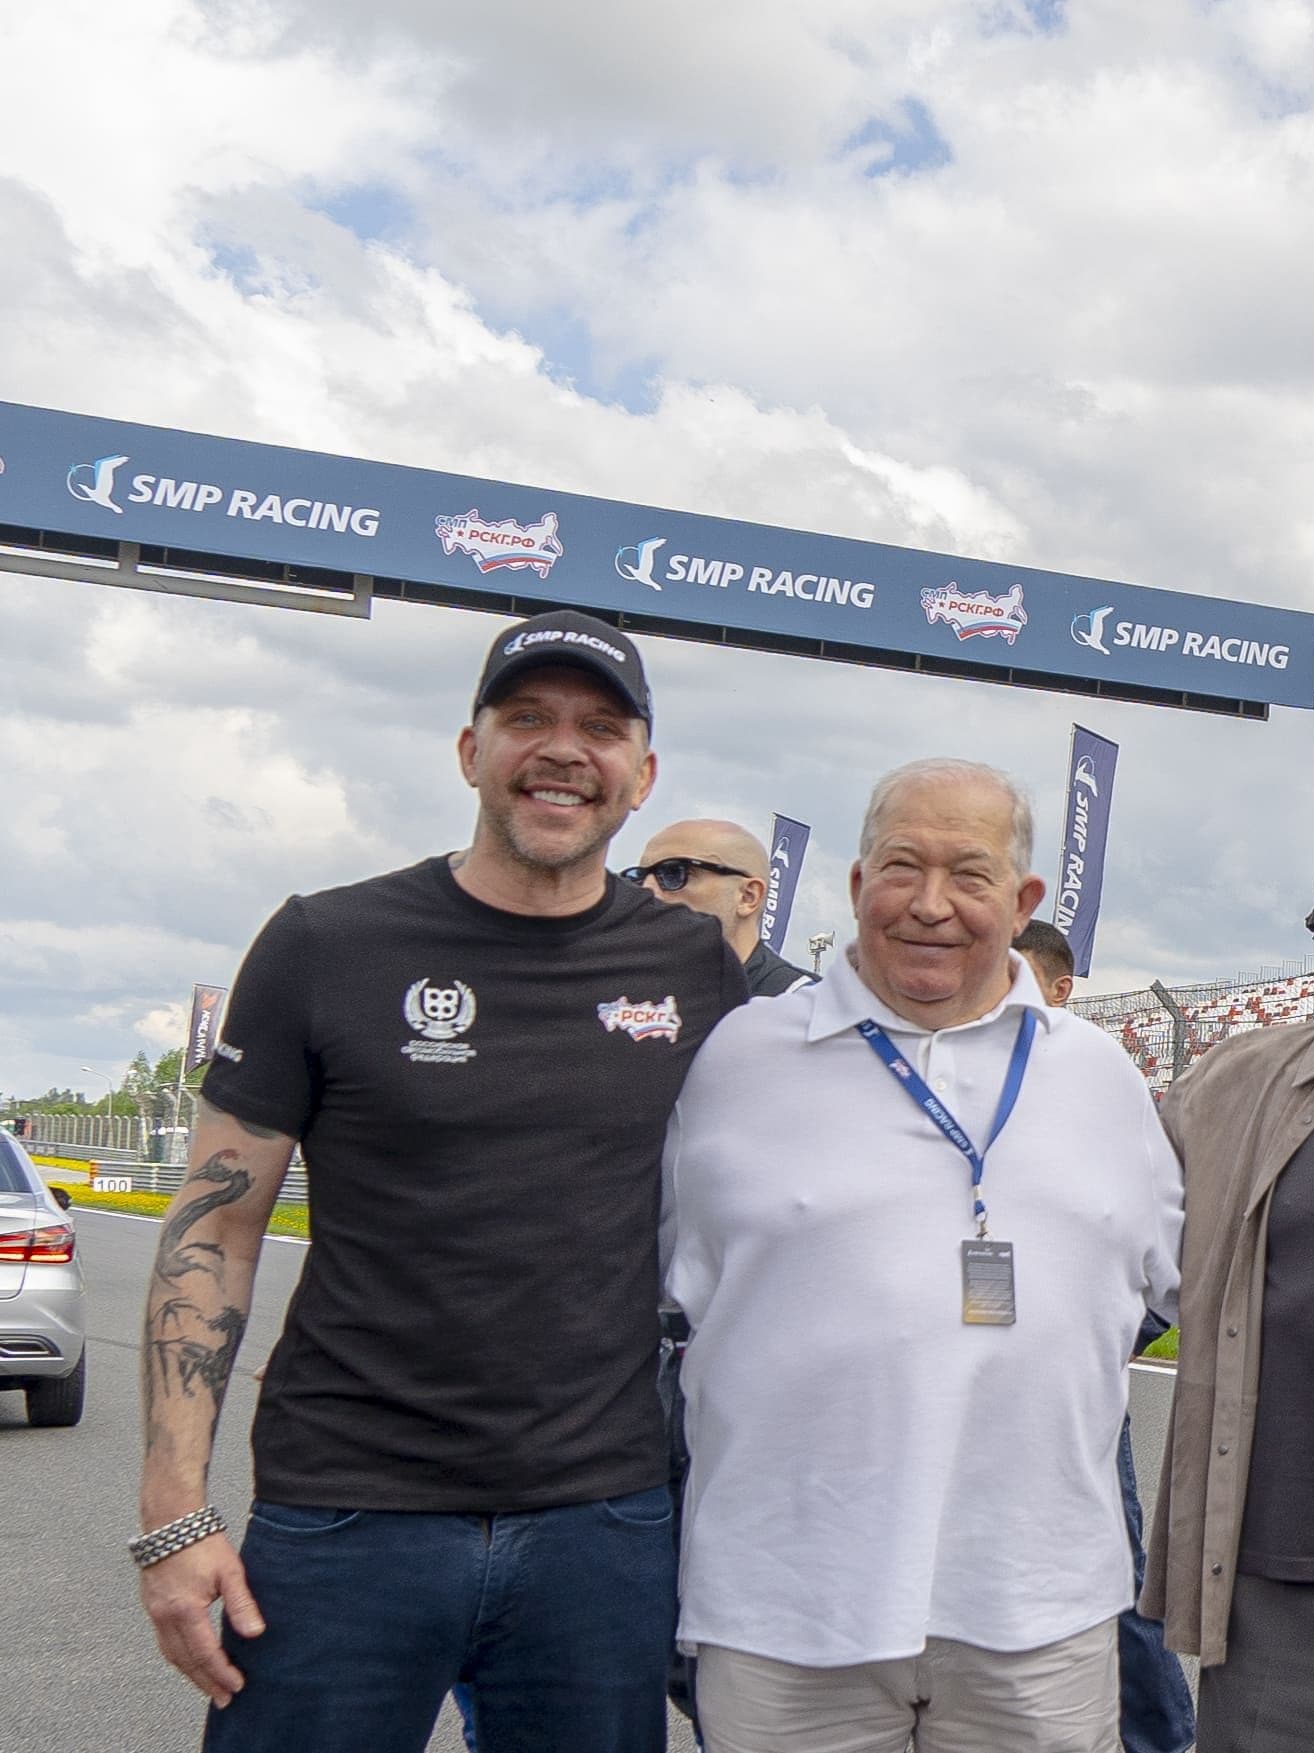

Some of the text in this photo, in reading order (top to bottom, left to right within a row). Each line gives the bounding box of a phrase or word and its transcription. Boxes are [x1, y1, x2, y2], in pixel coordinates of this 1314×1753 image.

[128, 474, 381, 537] SMP RACING
[468, 529, 535, 548] РСКГ.РФ
[666, 554, 876, 609] SMP RACING
[948, 600, 1004, 617] РСКГ.РФ
[523, 630, 626, 662] SMP RACING
[1113, 621, 1290, 670] SMP RACING
[1053, 790, 1089, 936] SMP RACIN
[621, 1009, 667, 1023] РСКГ
[924, 1097, 952, 1129] RACING
[97, 1179, 128, 1192] 100
